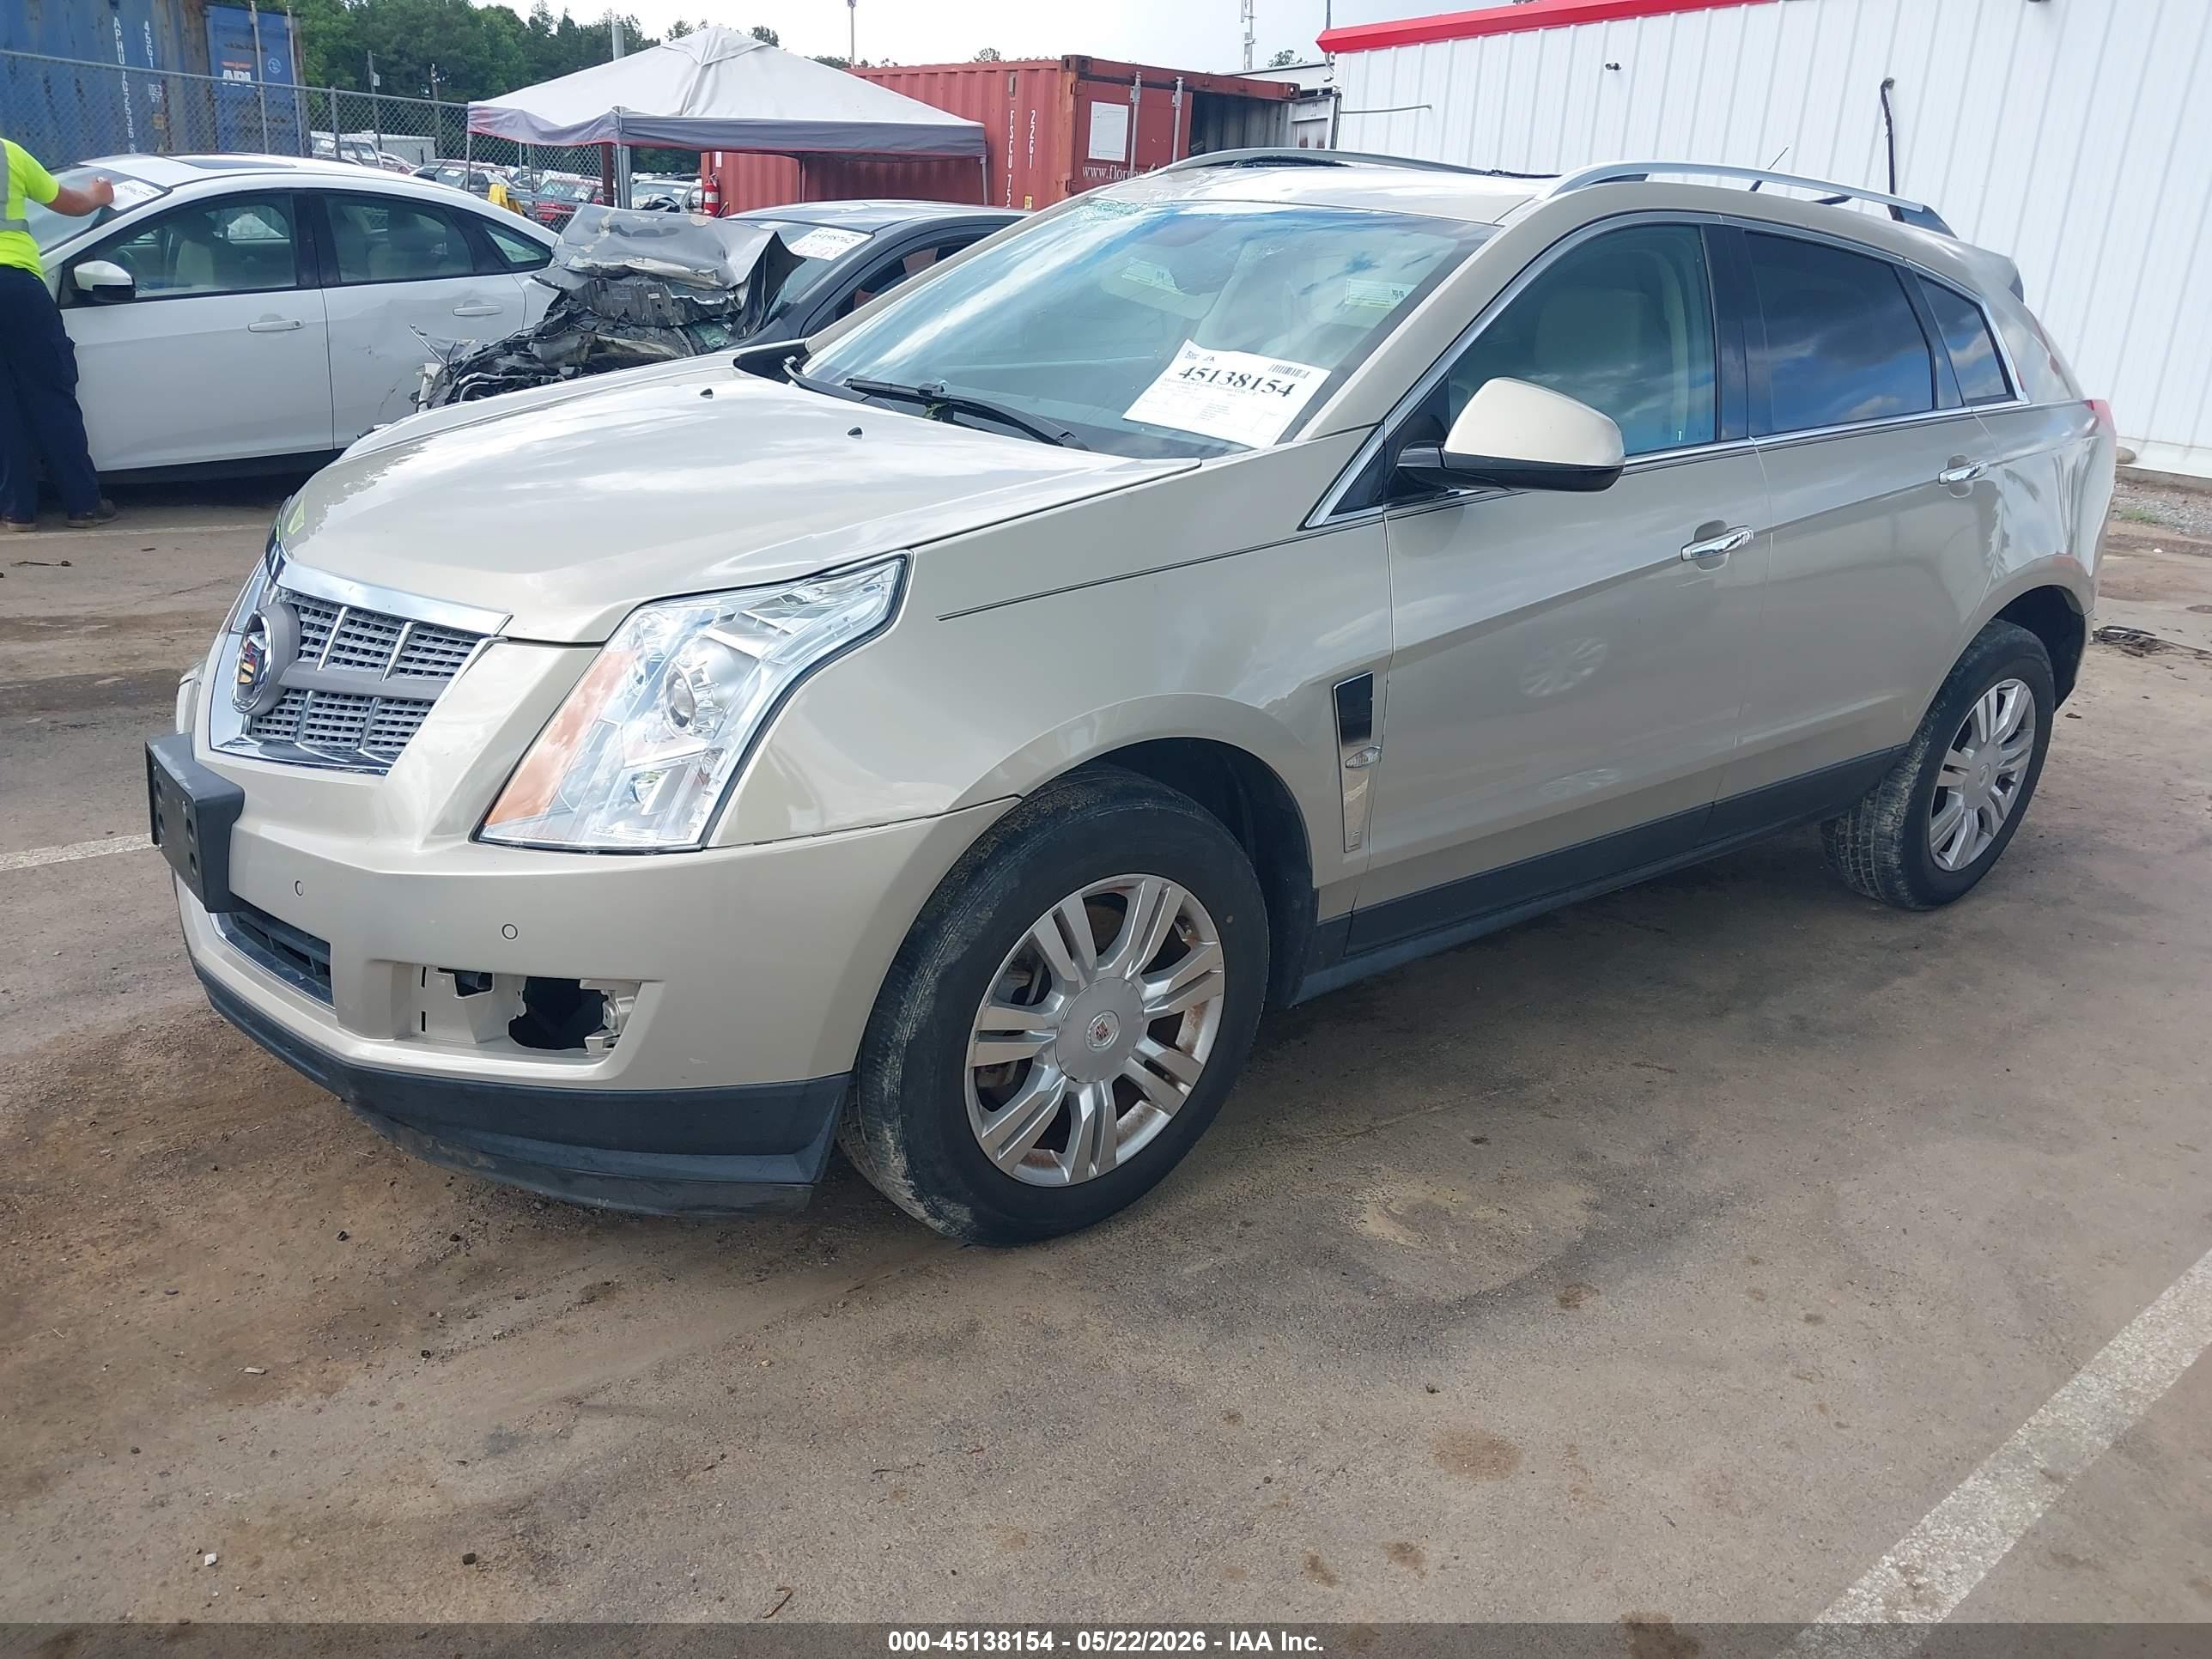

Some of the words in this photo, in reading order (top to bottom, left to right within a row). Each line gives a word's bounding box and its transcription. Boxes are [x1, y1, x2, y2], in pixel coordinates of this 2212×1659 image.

[114, 17, 125, 64] APHU
[144, 21, 154, 69] 45G1
[1178, 367, 1297, 397] 45138154
